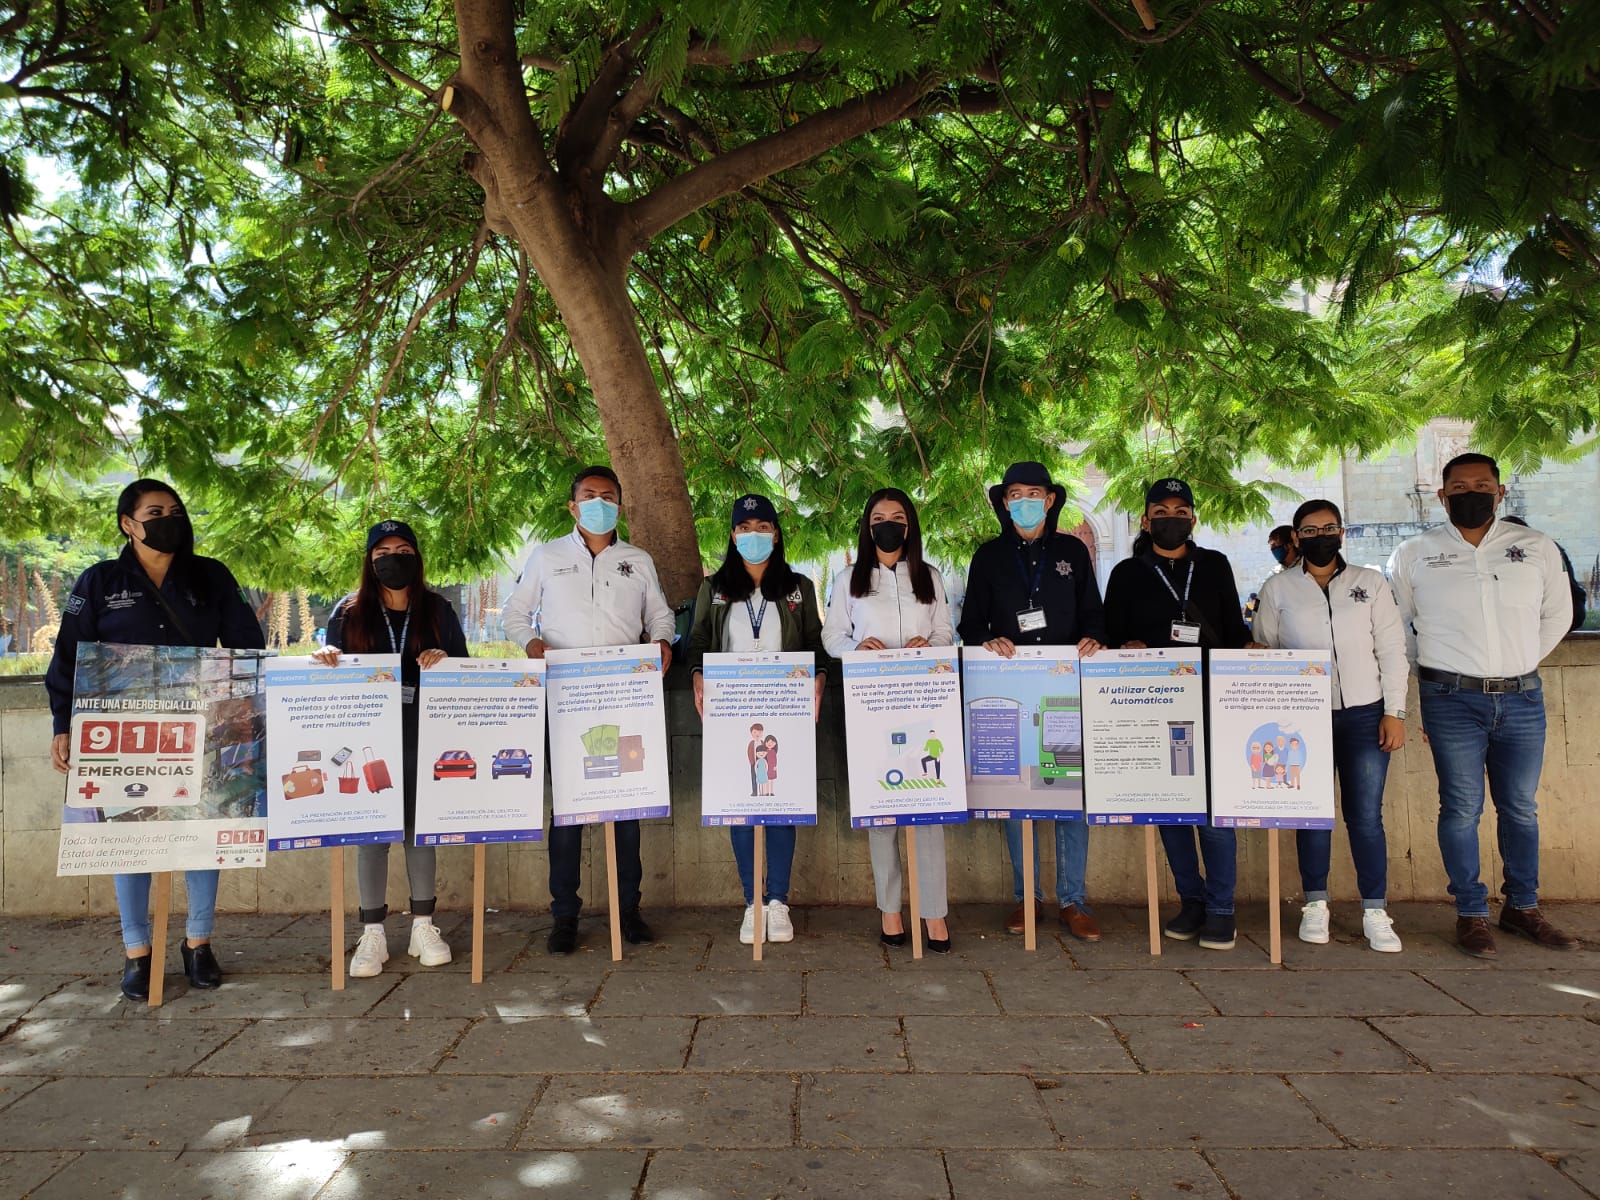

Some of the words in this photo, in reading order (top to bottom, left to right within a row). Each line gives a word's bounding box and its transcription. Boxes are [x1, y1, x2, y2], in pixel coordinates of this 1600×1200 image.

[1111, 686, 1146, 694] utilizar
[1148, 685, 1185, 695] Cajeros
[75, 699, 100, 710] ANTE
[101, 699, 120, 710] UNA
[122, 699, 179, 711] EMERGENCIA
[181, 700, 209, 711] LLAME
[1111, 696, 1174, 705] Automáticos
[290, 713, 335, 722] personales
[89, 725, 185, 750] 911
[77, 766, 194, 777] EMERGENCIAS
[63, 837, 85, 845] Toda
[87, 836, 97, 845] la
[100, 834, 150, 847] Tecnología
[152, 834, 166, 843] del
[168, 834, 198, 842] Centro
[220, 831, 260, 843] 911
[61, 849, 94, 858] Estatal
[99, 848, 108, 857] de
[110, 847, 168, 859] Emergencias
[61, 862, 72, 870] en
[110, 858, 147, 867] número
